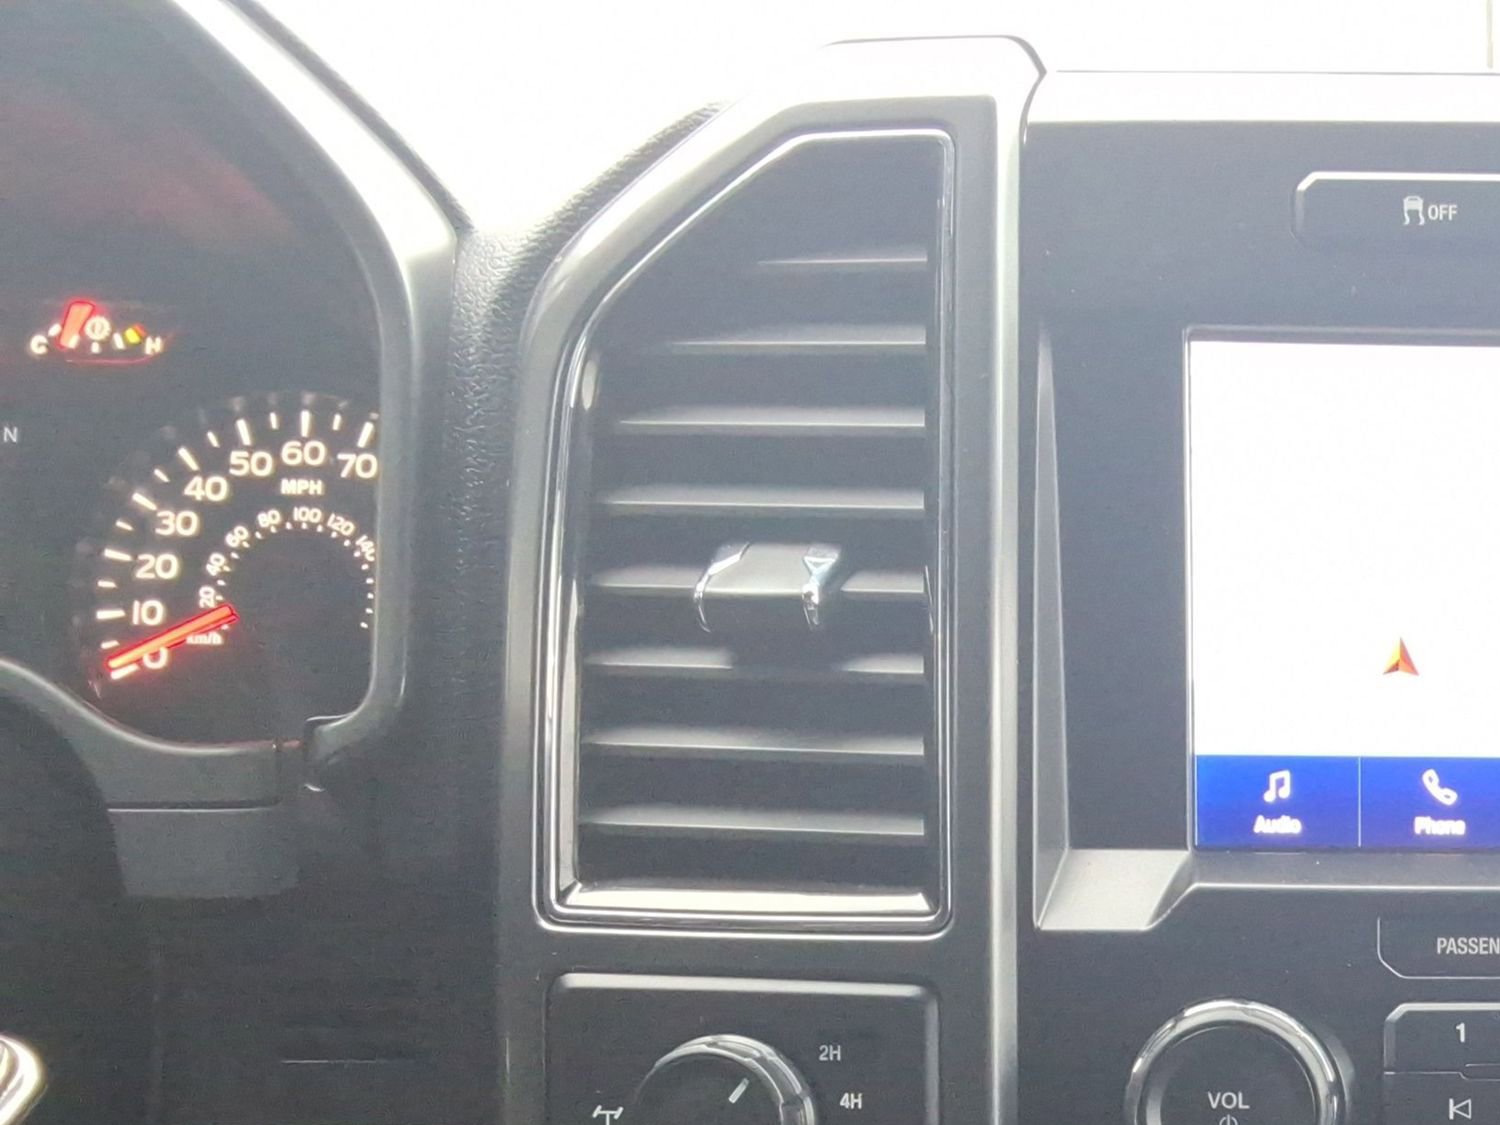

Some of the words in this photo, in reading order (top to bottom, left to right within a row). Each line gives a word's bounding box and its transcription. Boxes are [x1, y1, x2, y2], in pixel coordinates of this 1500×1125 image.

[1428, 204, 1457, 220] OFF
[30, 335, 48, 355] C
[145, 336, 163, 354] H
[4, 427, 17, 443] N
[229, 451, 273, 477] 50
[281, 441, 326, 467] 60
[338, 453, 379, 480] 70
[184, 476, 228, 502] 40
[281, 479, 324, 496] MPH
[155, 510, 199, 536] 30
[257, 509, 281, 529] 80
[293, 507, 322, 524] 100
[327, 512, 356, 536] 120
[225, 526, 250, 549] 60
[135, 554, 179, 580] 20
[206, 553, 227, 577] 40
[199, 586, 216, 608] 20
[132, 600, 164, 626] 10
[1254, 816, 1302, 835] Audio
[1414, 816, 1466, 836] Phone
[1455, 1023, 1466, 1043] 1
[819, 1045, 841, 1061] 2H
[840, 1092, 863, 1109] 4H
[1208, 1091, 1250, 1109] VOL
